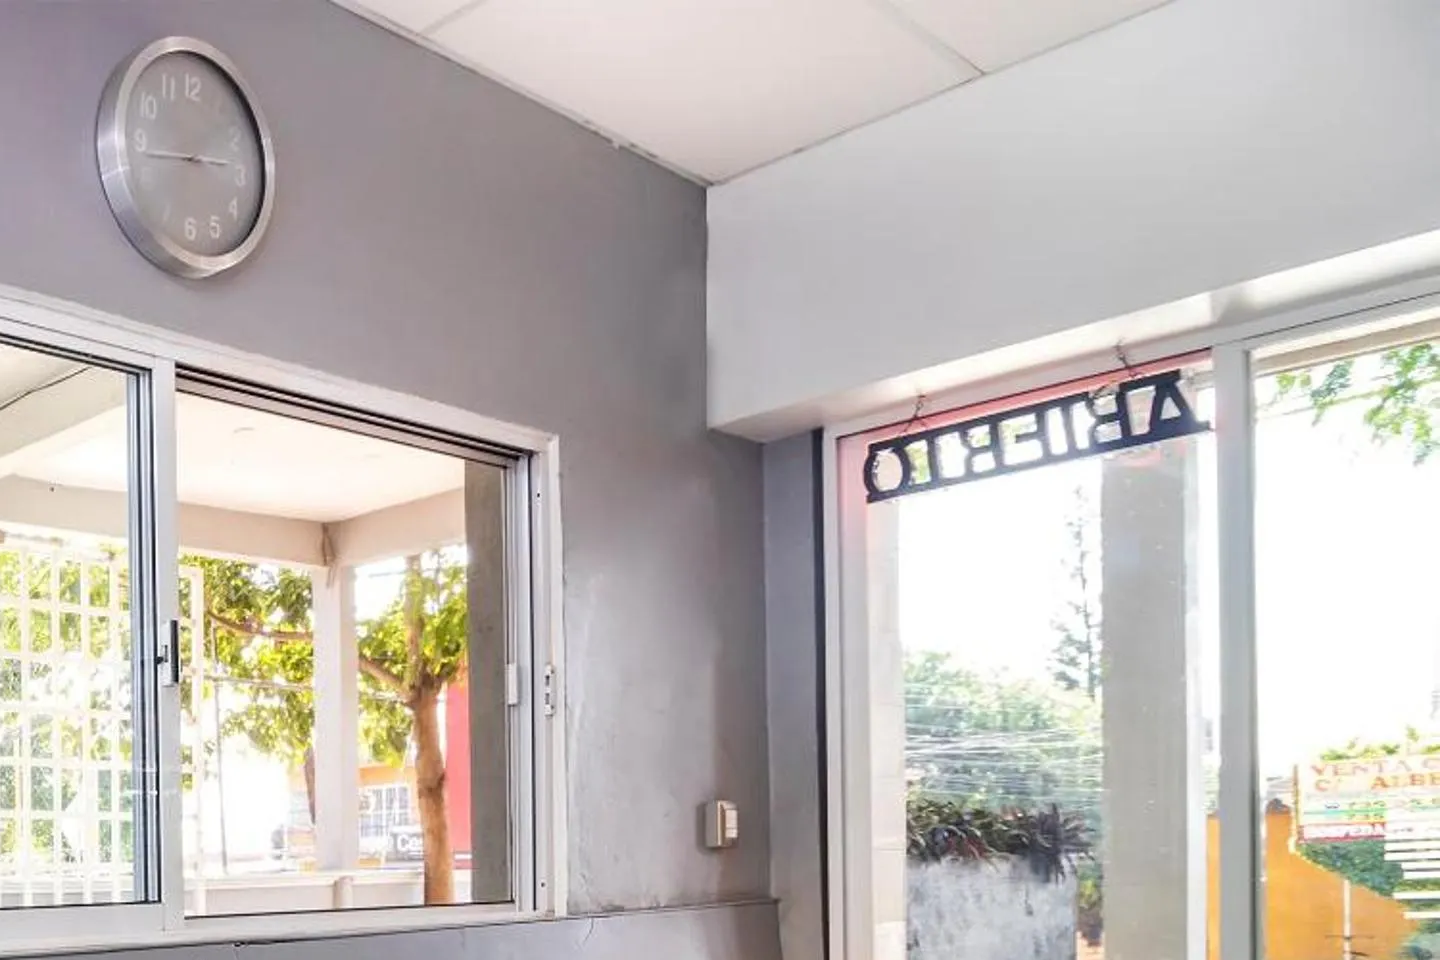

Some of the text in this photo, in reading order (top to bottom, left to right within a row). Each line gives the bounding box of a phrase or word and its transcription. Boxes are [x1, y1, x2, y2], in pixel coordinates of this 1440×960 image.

[162, 73, 175, 101] 11
[185, 72, 202, 102] 12
[141, 91, 158, 120] 10
[134, 127, 147, 152] 9
[229, 125, 242, 152] 2
[234, 165, 247, 187] 3
[229, 196, 239, 222] 4
[184, 217, 197, 241] 6
[209, 215, 222, 240] 5
[1311, 759, 1412, 776] VENTA
